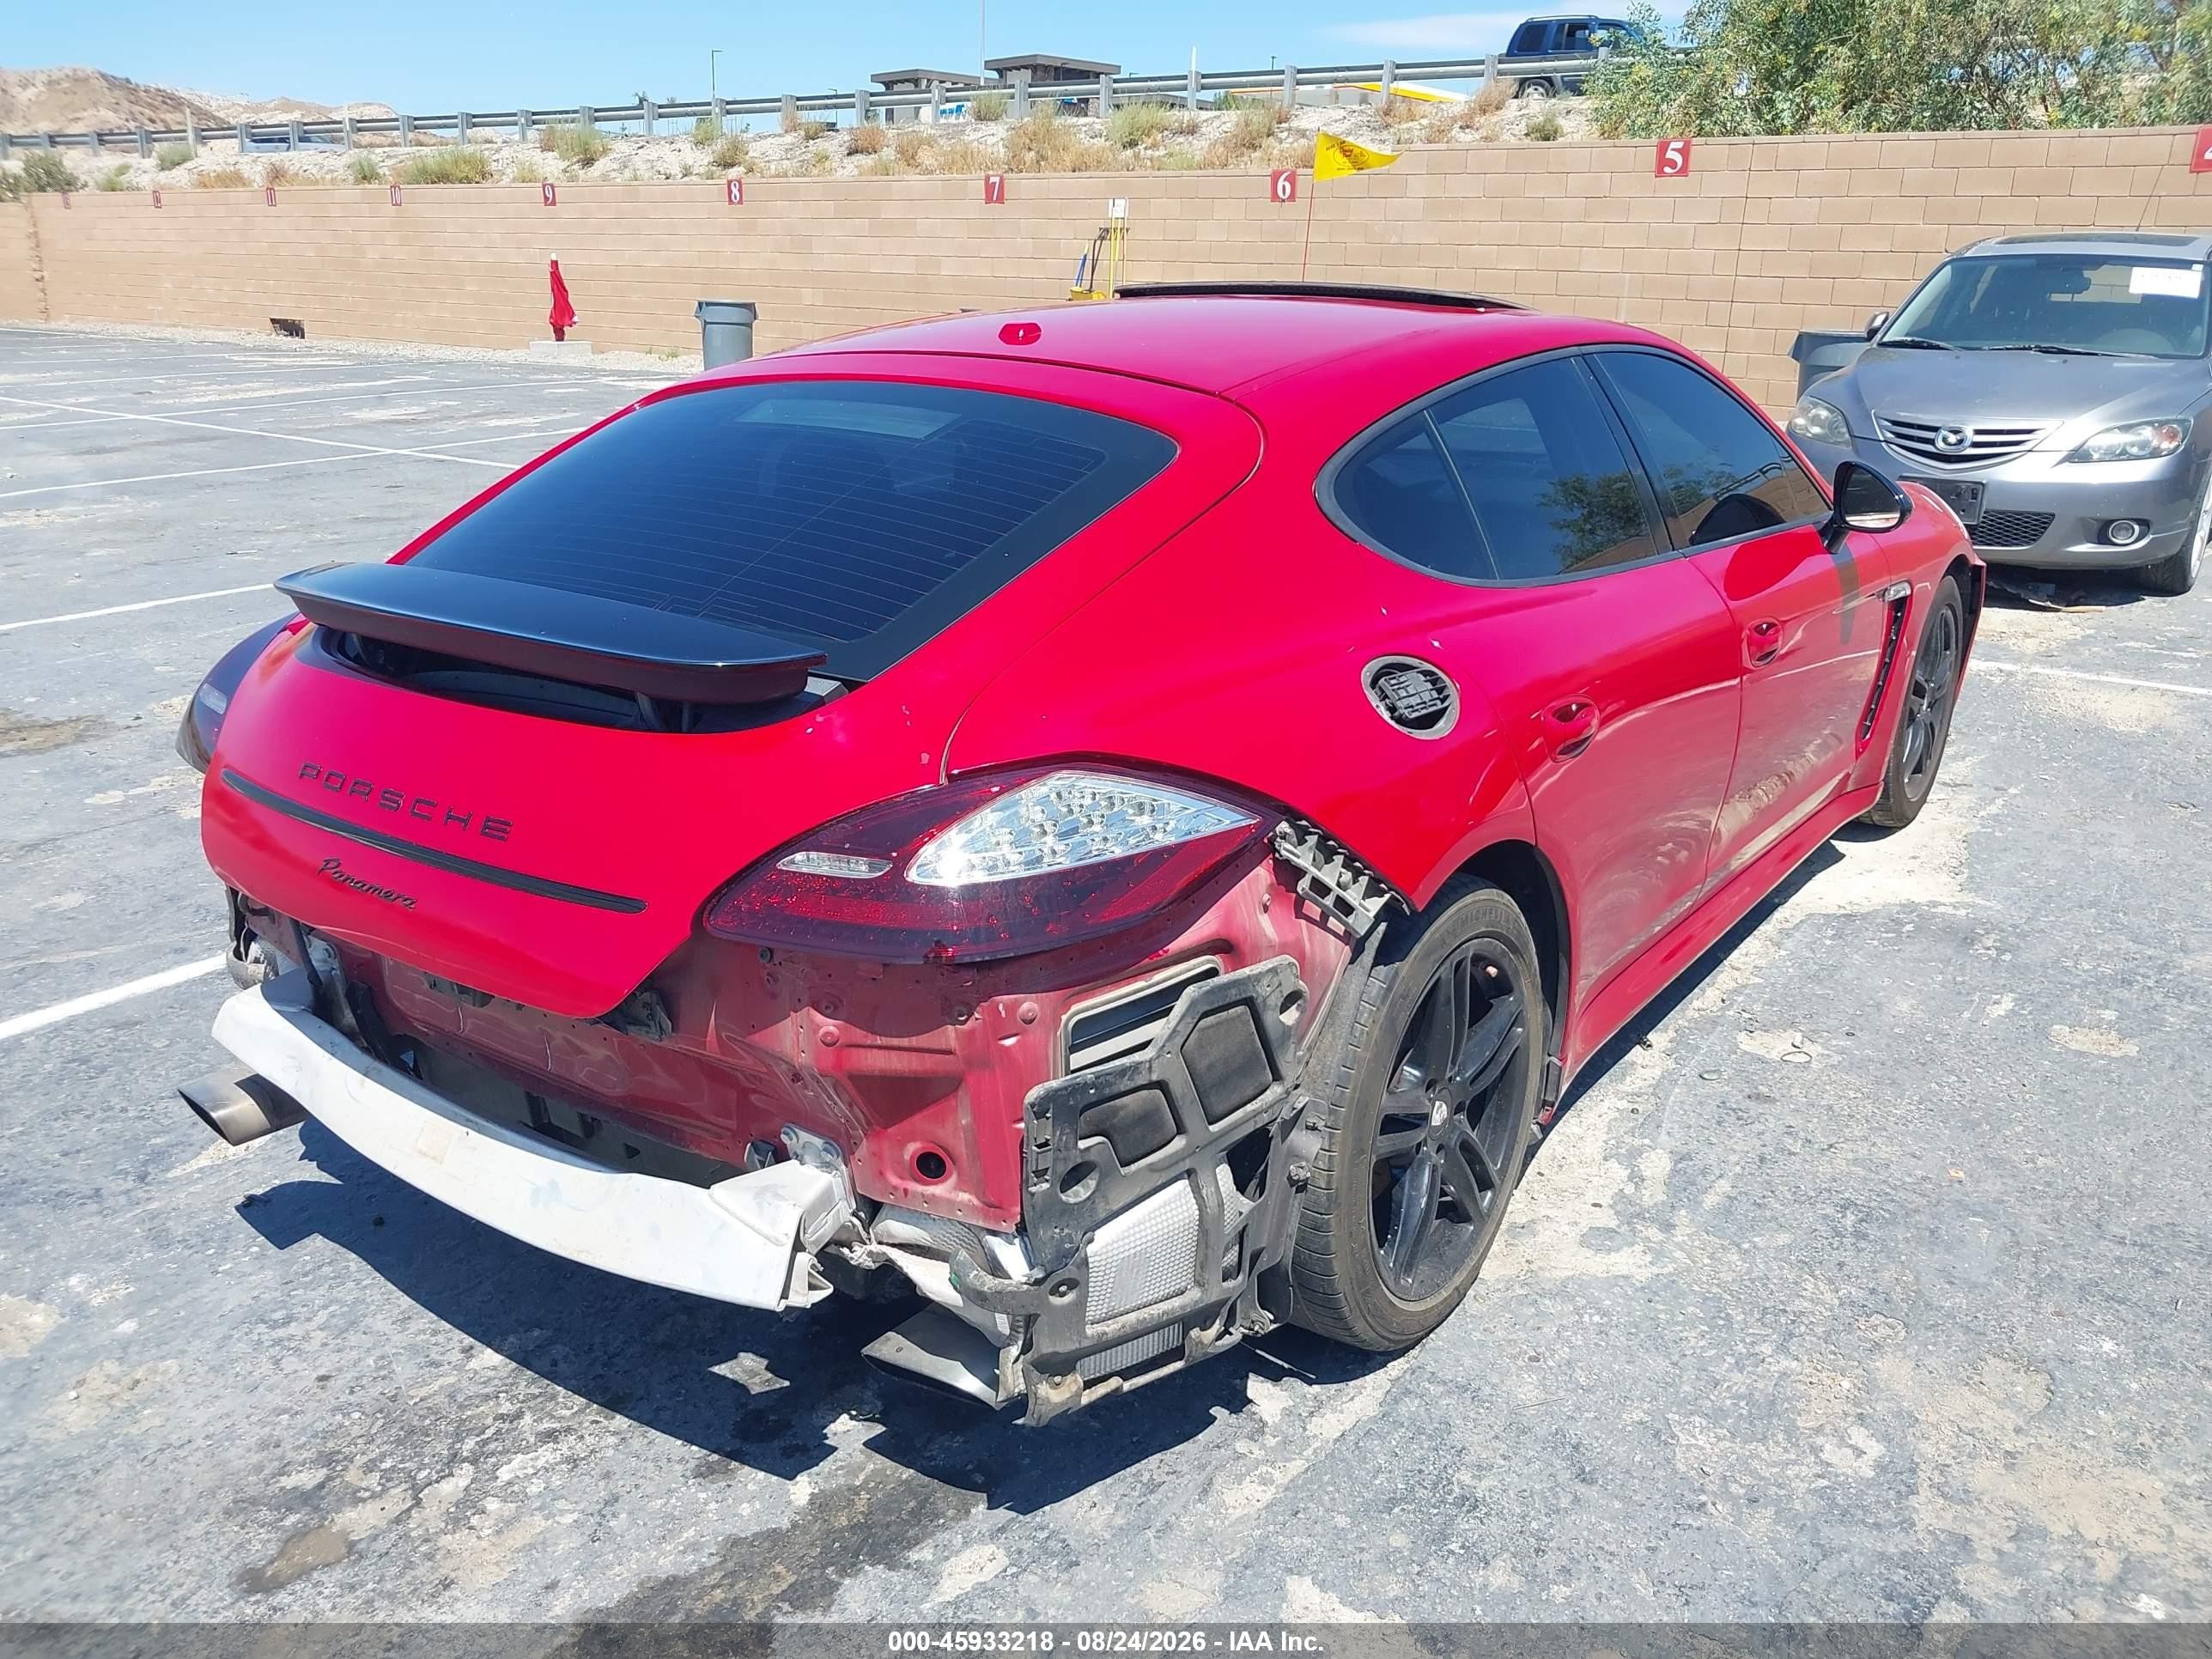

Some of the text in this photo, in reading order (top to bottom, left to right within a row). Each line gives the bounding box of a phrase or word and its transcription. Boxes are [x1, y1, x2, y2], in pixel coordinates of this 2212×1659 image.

[1662, 141, 1685, 173] 5
[266, 188, 276, 205] 11
[392, 186, 401, 204] 10
[544, 185, 553, 204] 9
[730, 180, 740, 203] 8
[988, 176, 1000, 201] 7
[1277, 172, 1291, 199] 6
[299, 762, 514, 841] PORSCHE
[316, 857, 417, 911] Panamera
